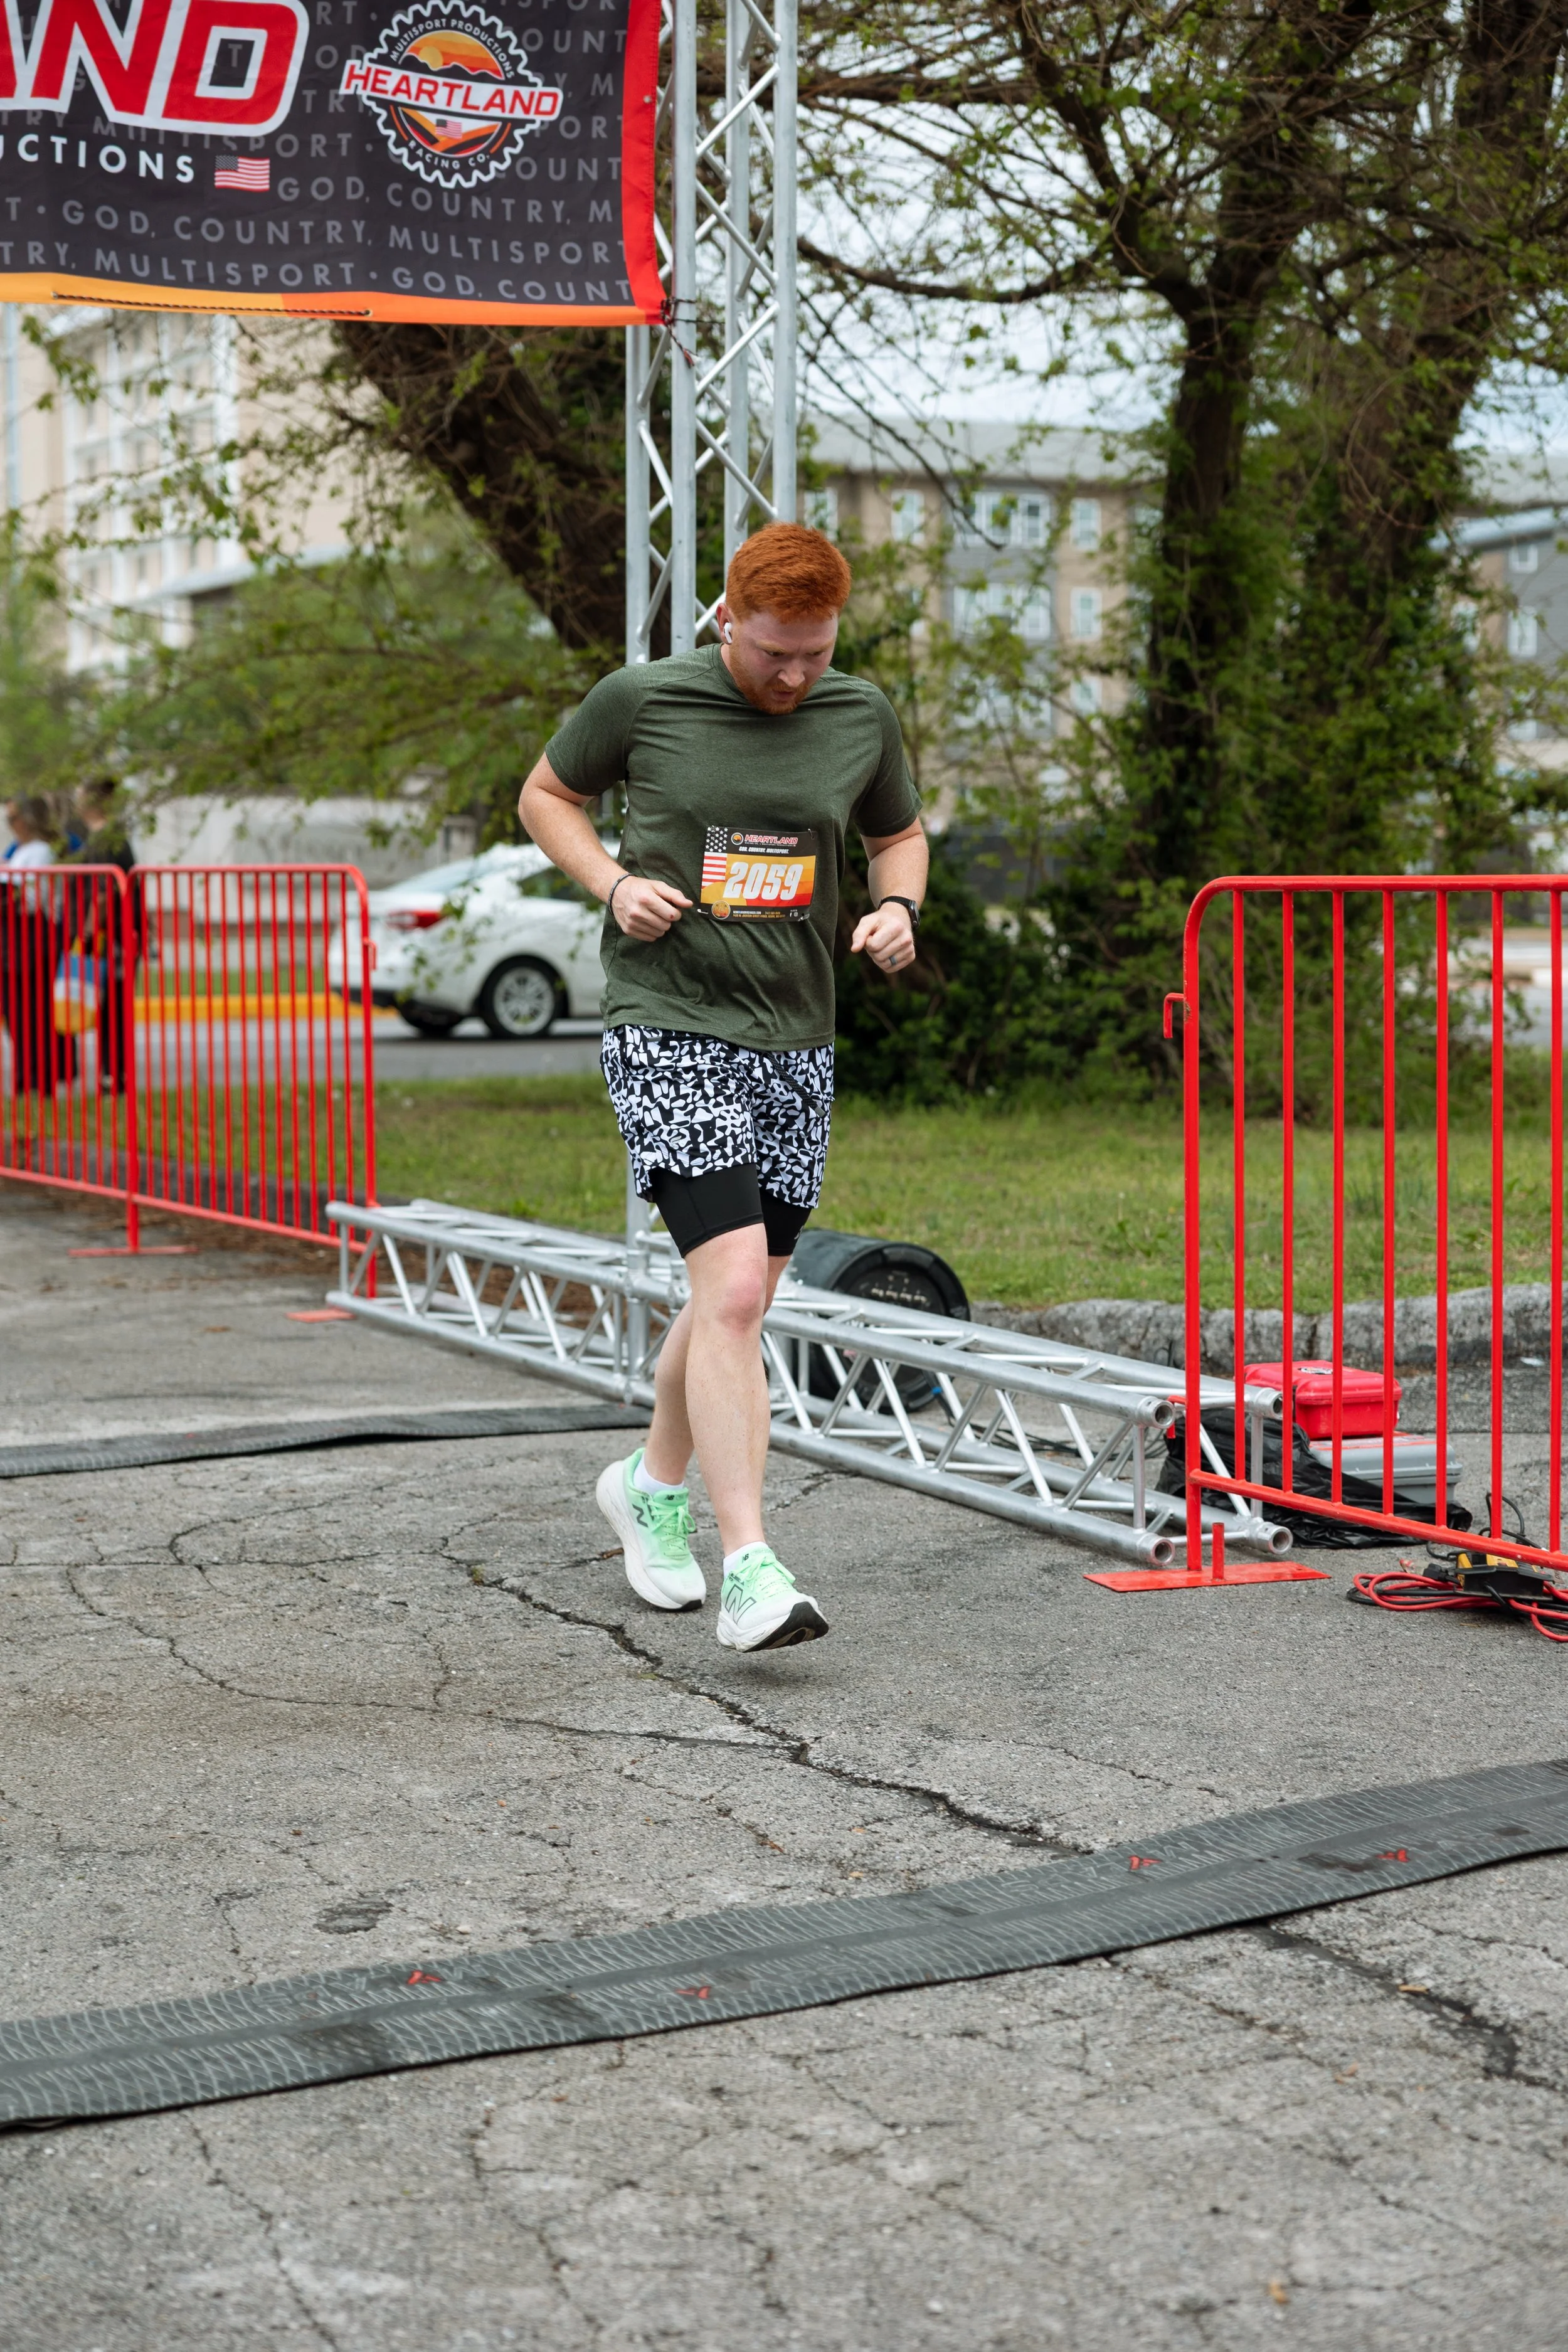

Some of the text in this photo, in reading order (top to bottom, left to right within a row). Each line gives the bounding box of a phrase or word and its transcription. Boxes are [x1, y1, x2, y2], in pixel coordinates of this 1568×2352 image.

[389, 18, 515, 78] MULTISPORT PRODUCTIONS
[502, 26, 627, 53] OUNT
[344, 65, 559, 116] HEARTLAND
[0, 134, 194, 183] CTIONS
[408, 140, 460, 170] RACING
[278, 177, 370, 203] GOD,
[387, 183, 571, 225] COUNTRY,
[63, 200, 156, 238] GOD,
[174, 216, 372, 246] COUNTRY,
[389, 226, 627, 265] MULTISPOR
[95, 248, 354, 286] MULTISPORT
[392, 267, 482, 299] GOD,
[744, 834, 798, 845] HEARTLAND
[723, 862, 803, 901] 2059
